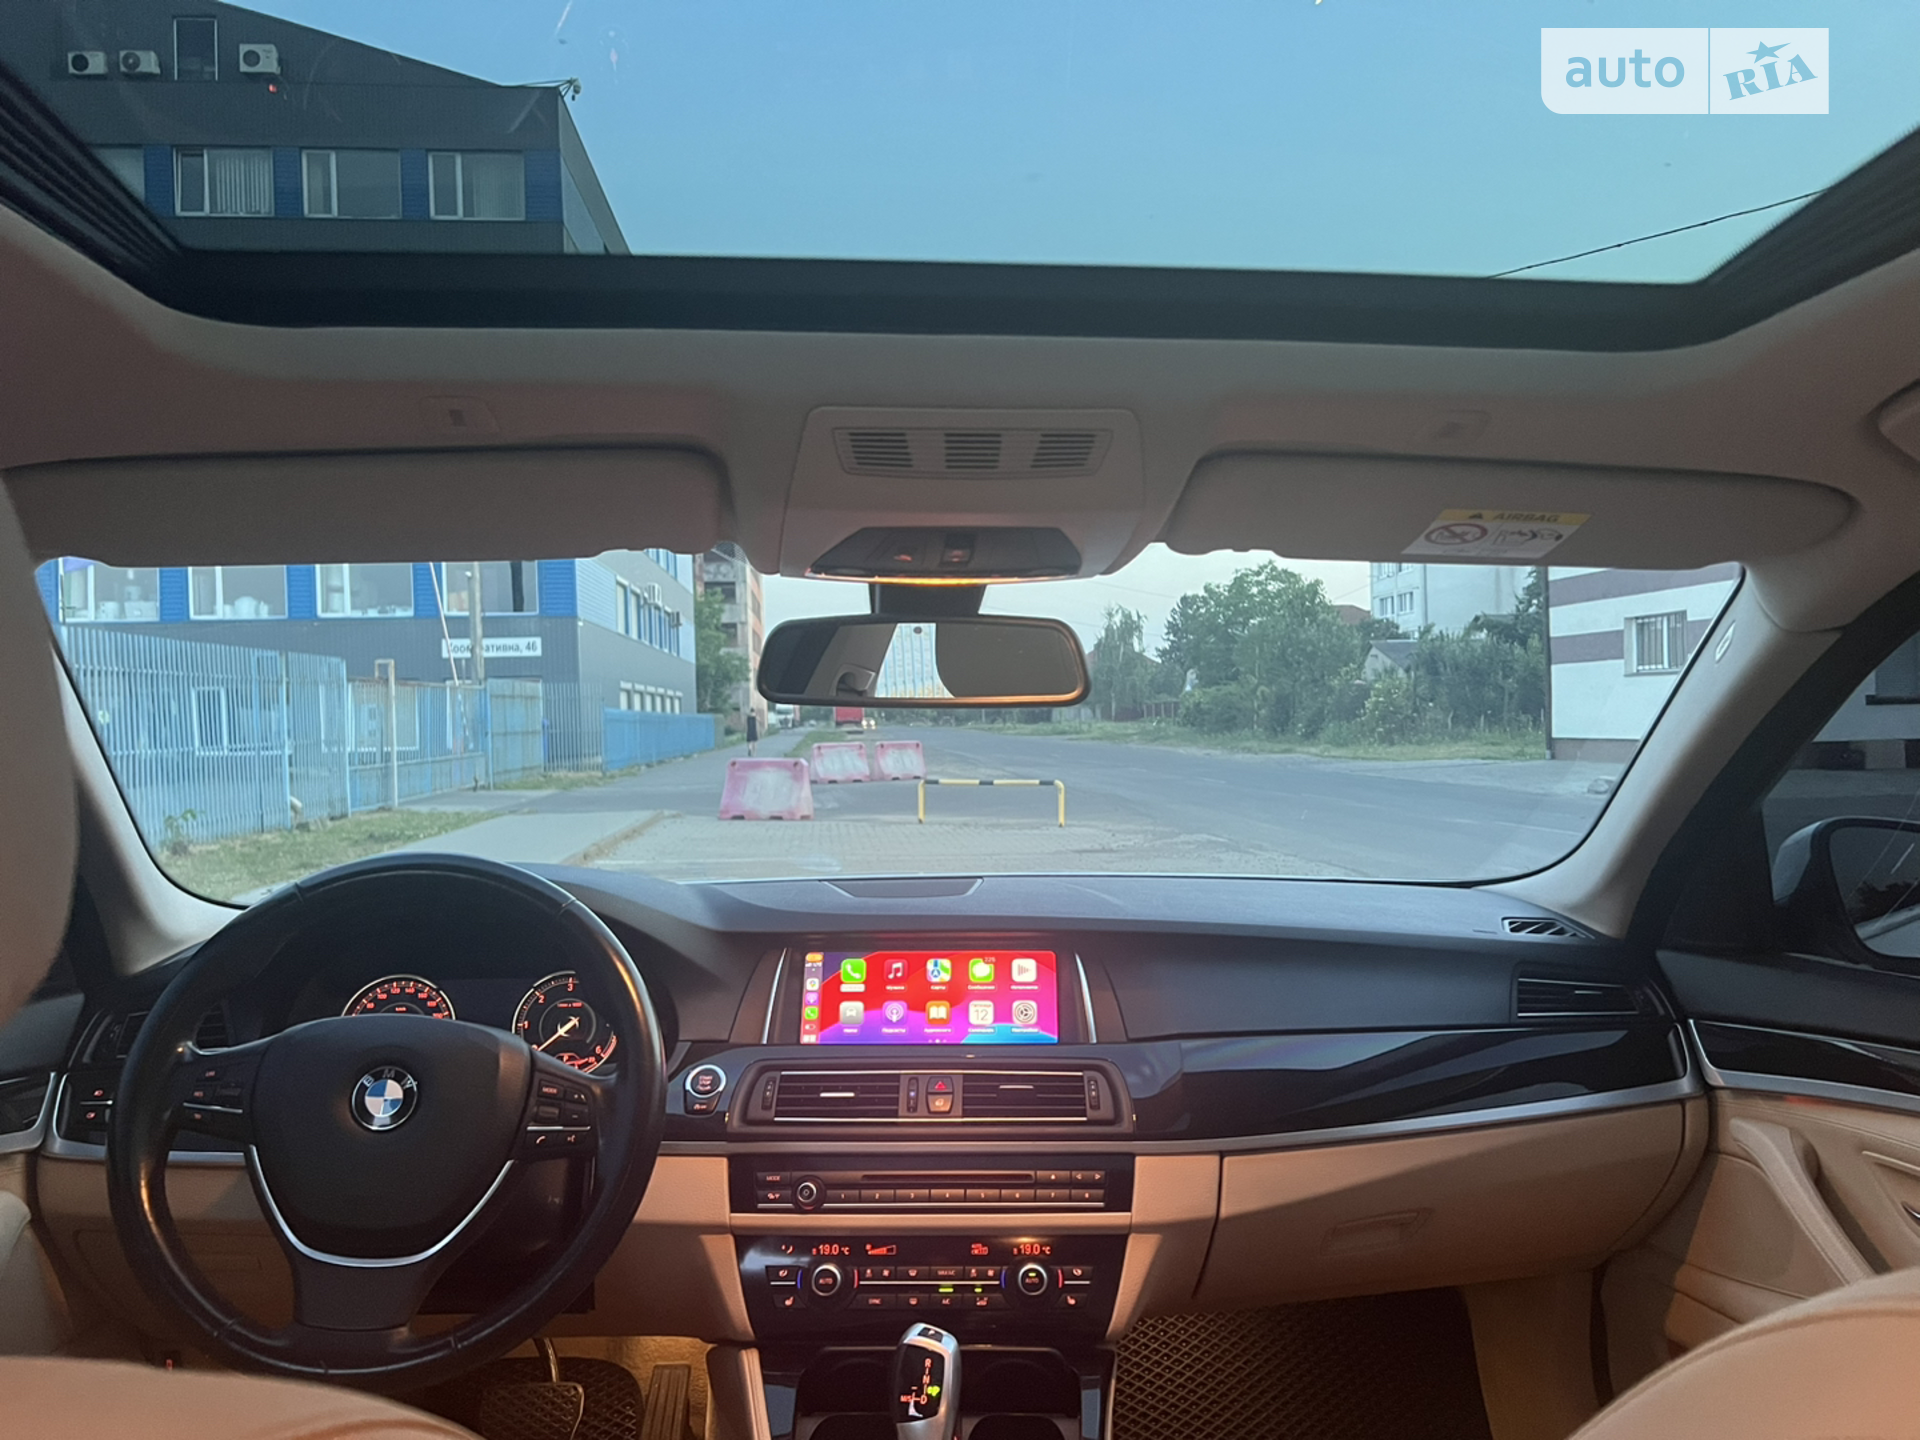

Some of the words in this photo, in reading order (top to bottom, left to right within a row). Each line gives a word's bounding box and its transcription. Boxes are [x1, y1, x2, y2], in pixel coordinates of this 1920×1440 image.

[1493, 512, 1561, 522] AIRBAG
[525, 641, 538, 652] 46
[567, 983, 575, 992] 3
[538, 994, 546, 1004] 2
[974, 1008, 989, 1021] 12
[362, 1068, 418, 1089] BMW
[818, 1244, 840, 1255] 19.0
[1019, 1244, 1040, 1255] 19.0
[819, 1277, 833, 1285] AUTO
[1025, 1276, 1039, 1284] AUTO
[924, 1358, 931, 1368] R
[922, 1374, 930, 1384] N
[920, 1395, 928, 1404] D
